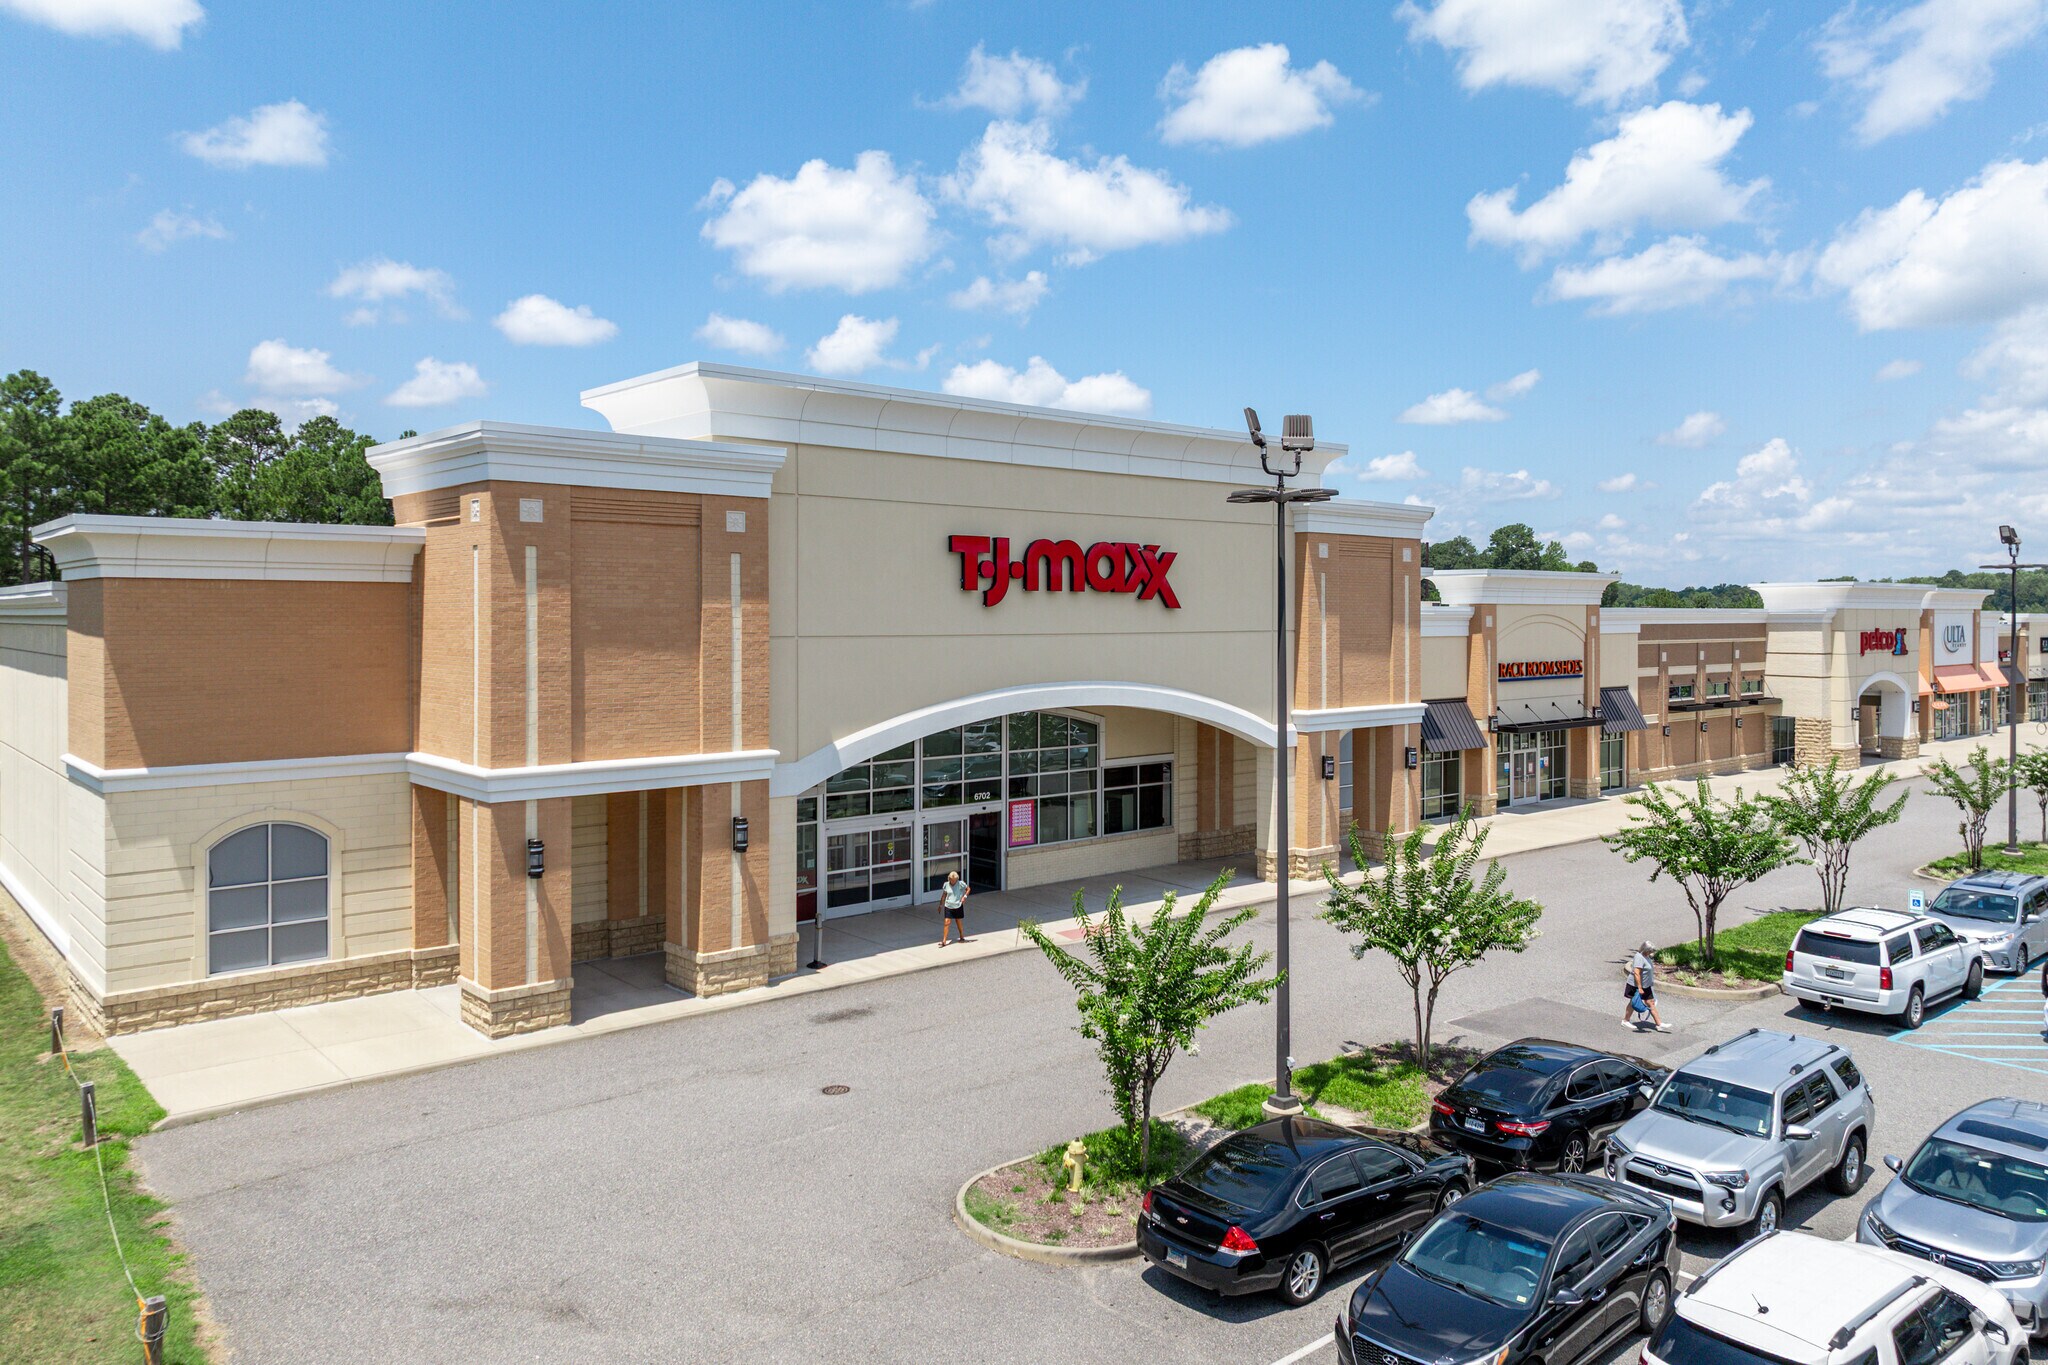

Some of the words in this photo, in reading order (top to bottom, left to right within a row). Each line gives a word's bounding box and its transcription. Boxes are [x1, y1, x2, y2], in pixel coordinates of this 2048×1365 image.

[1860, 628, 1894, 656] petco
[1946, 625, 1966, 643] ULTA
[1498, 662, 1524, 677] RACK
[1525, 661, 1554, 676] ROOM
[1554, 660, 1583, 674] SHOES
[974, 792, 990, 800] 6702
